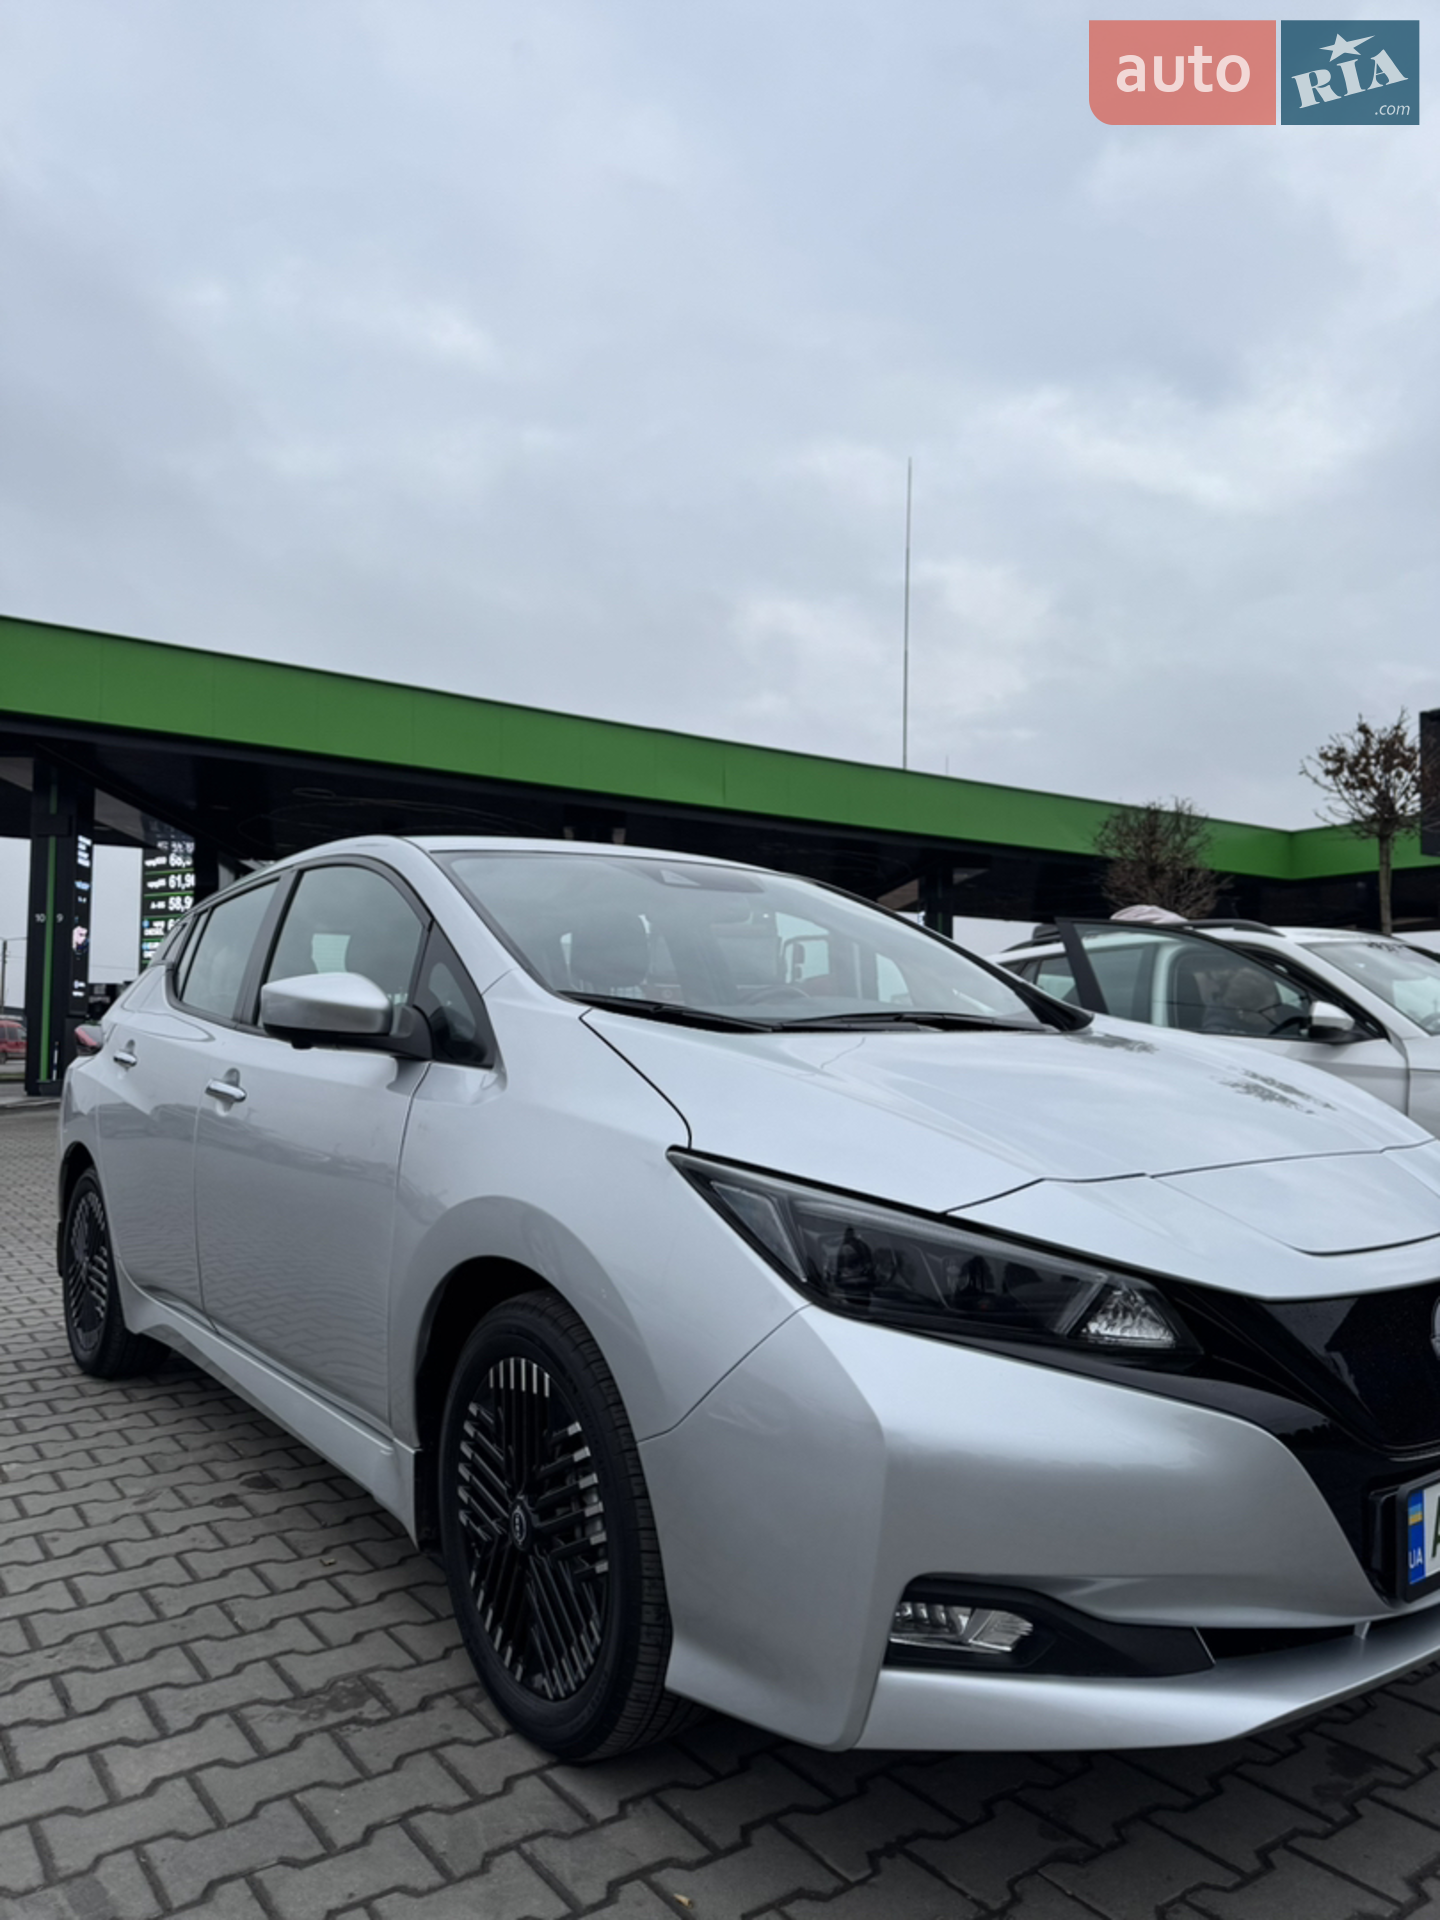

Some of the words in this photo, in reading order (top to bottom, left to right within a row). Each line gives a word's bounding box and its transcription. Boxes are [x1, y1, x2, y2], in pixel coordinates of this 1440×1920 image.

[35, 913, 46, 924] 10
[56, 913, 64, 924] 9
[1408, 1547, 1423, 1569] UA
